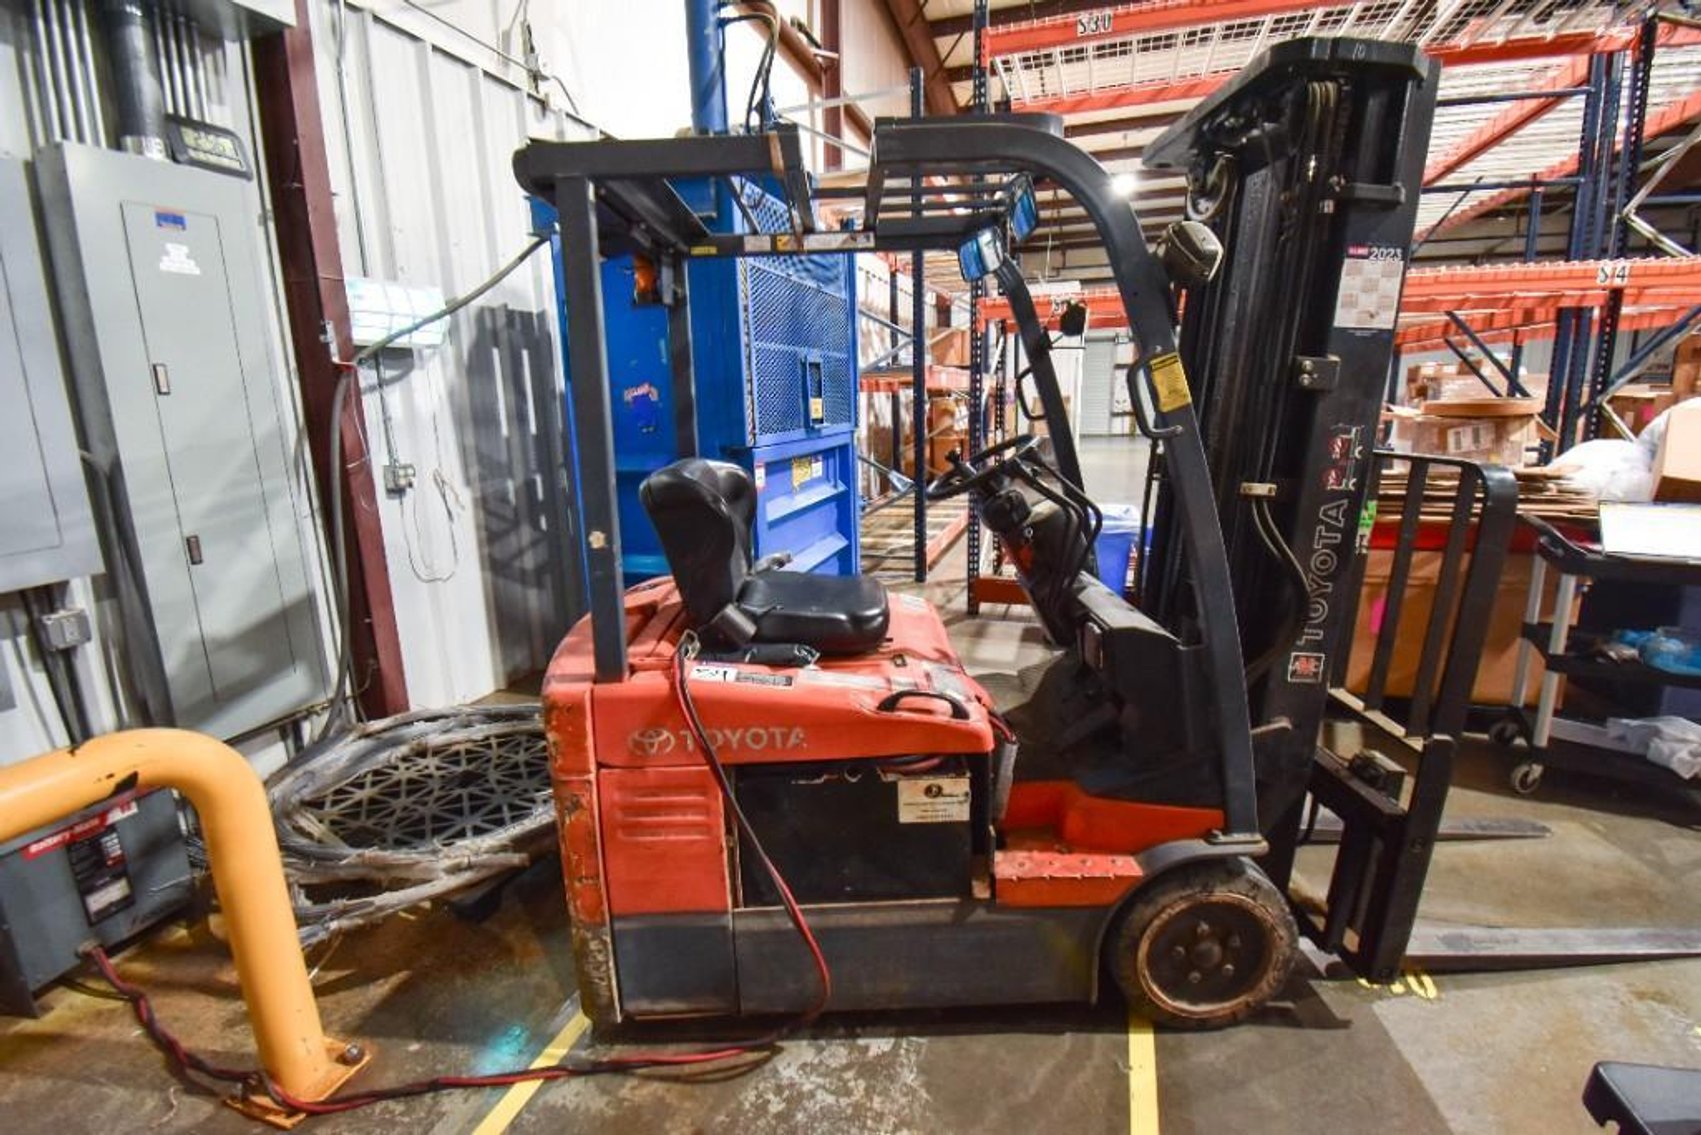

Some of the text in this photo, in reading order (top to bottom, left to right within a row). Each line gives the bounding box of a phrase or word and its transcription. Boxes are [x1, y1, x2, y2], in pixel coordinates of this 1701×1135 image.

[1369, 247, 1403, 262] 2023
[1296, 499, 1349, 646] TOYOTA
[679, 726, 808, 752] TOYOTA
